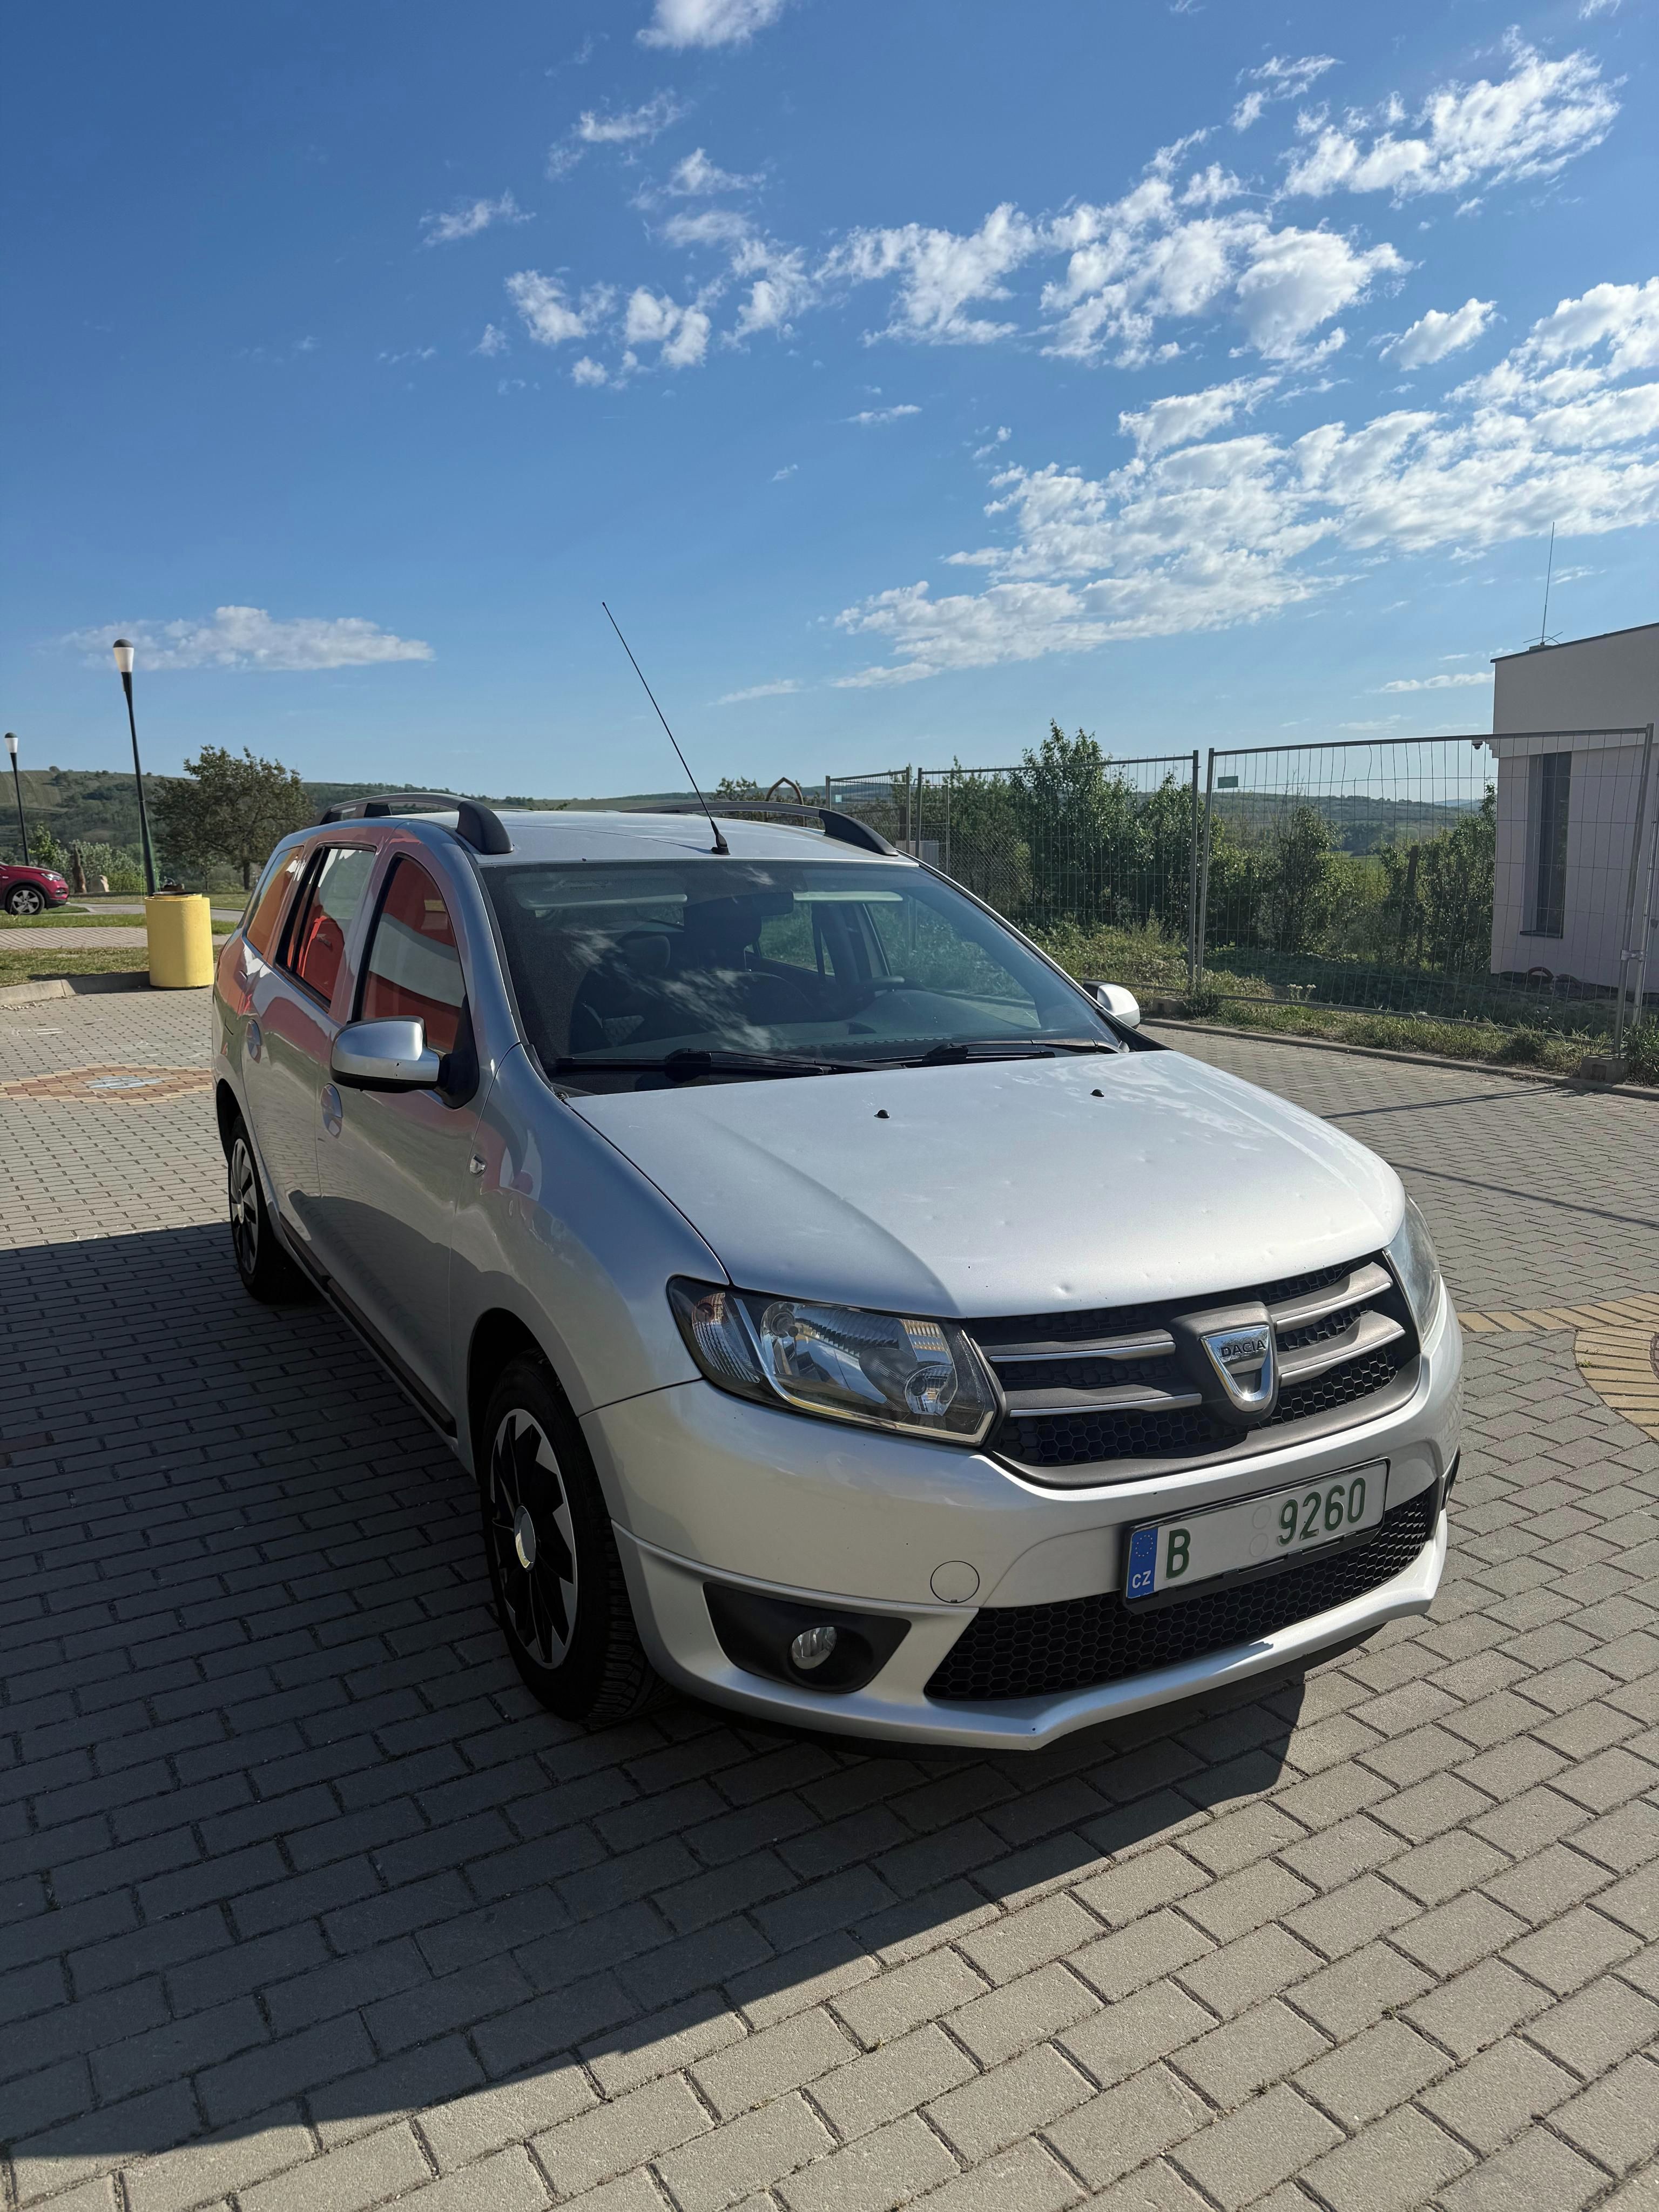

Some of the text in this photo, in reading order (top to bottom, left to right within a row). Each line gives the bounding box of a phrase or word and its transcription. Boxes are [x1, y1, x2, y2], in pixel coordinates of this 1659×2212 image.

[1220, 1340, 1266, 1358] DACIA
[1166, 1477, 1366, 1580] B 9260
[1132, 1570, 1151, 1588] CZ
